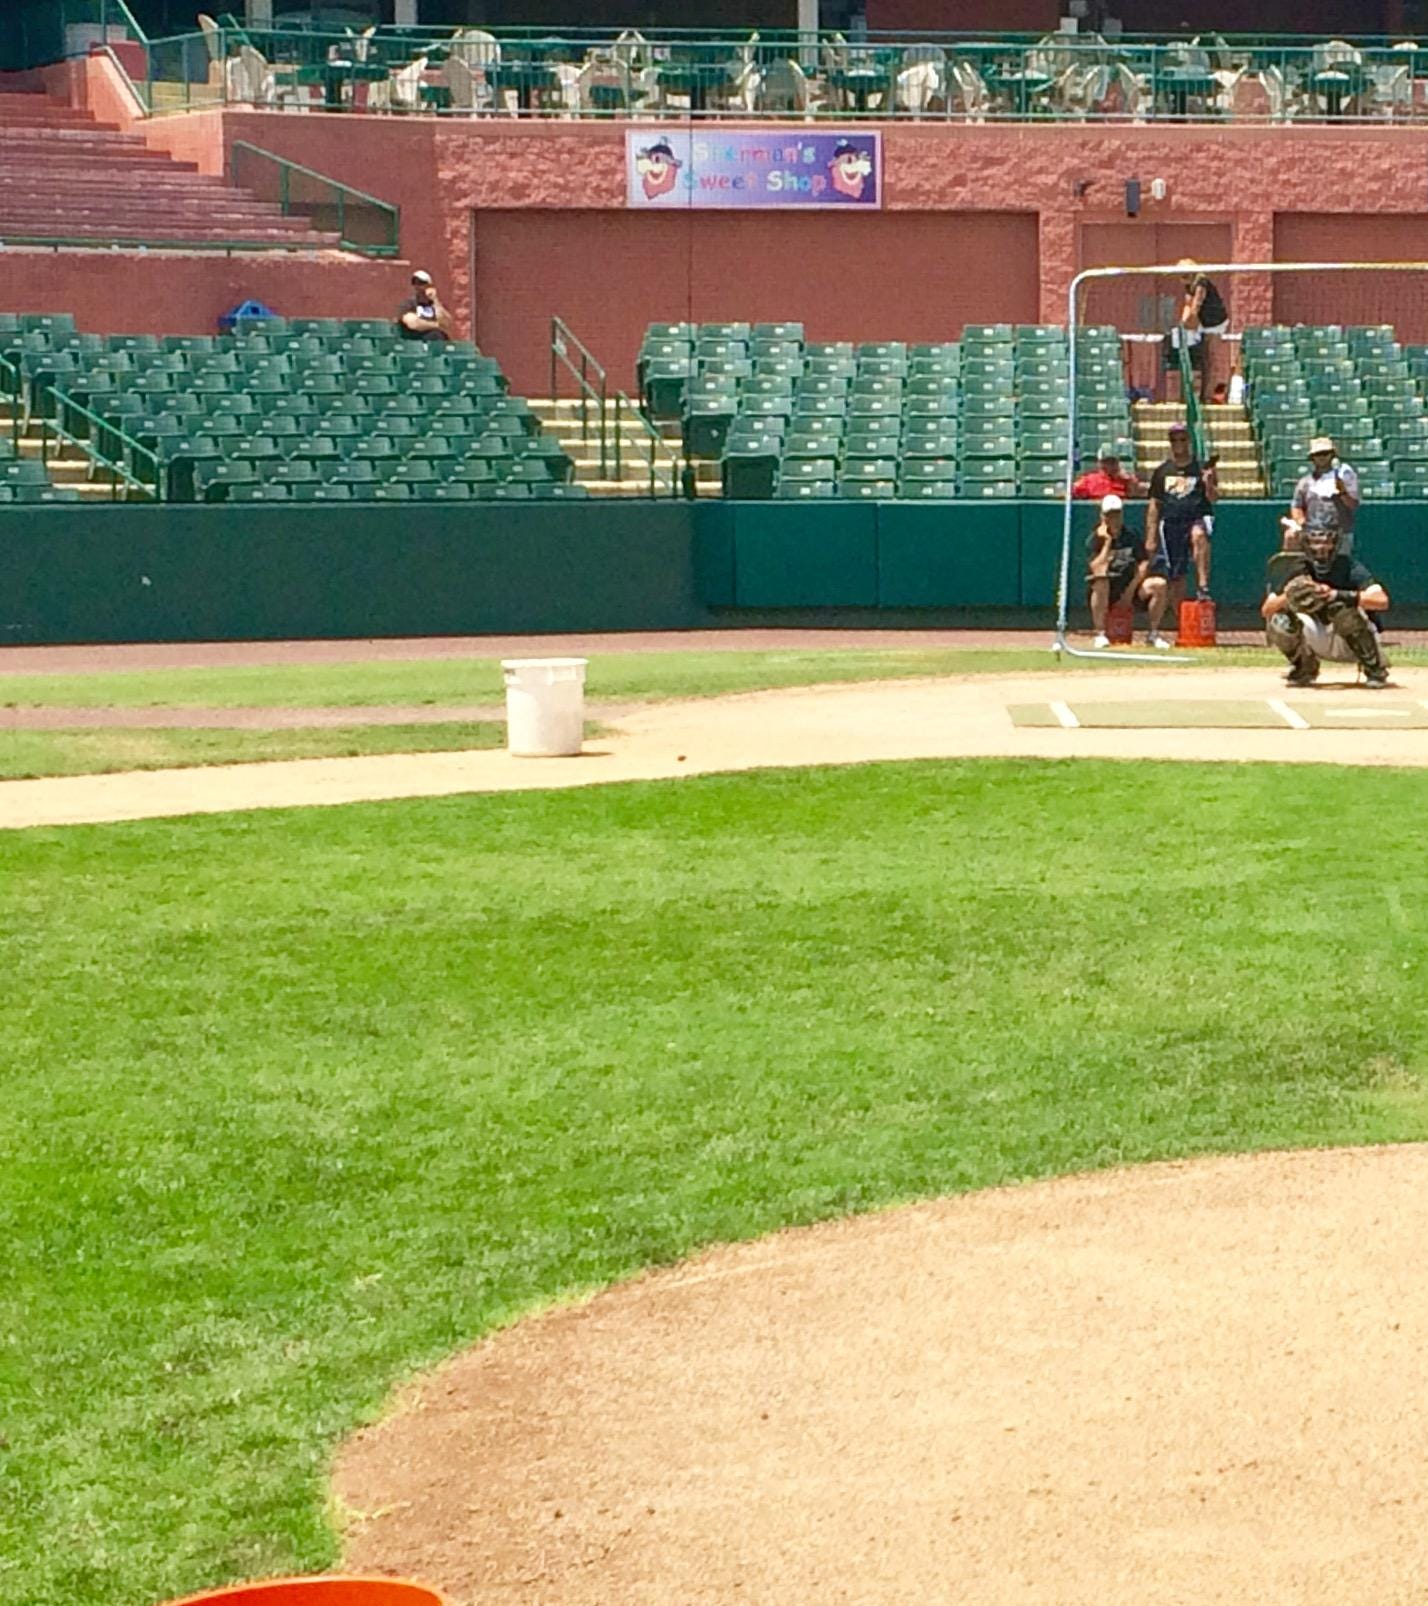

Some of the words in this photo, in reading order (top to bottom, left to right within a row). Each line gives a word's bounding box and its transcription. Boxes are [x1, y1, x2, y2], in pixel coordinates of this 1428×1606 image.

[693, 141, 816, 164] Sherman's
[682, 169, 757, 191] Sweet
[766, 170, 826, 197] Shop
